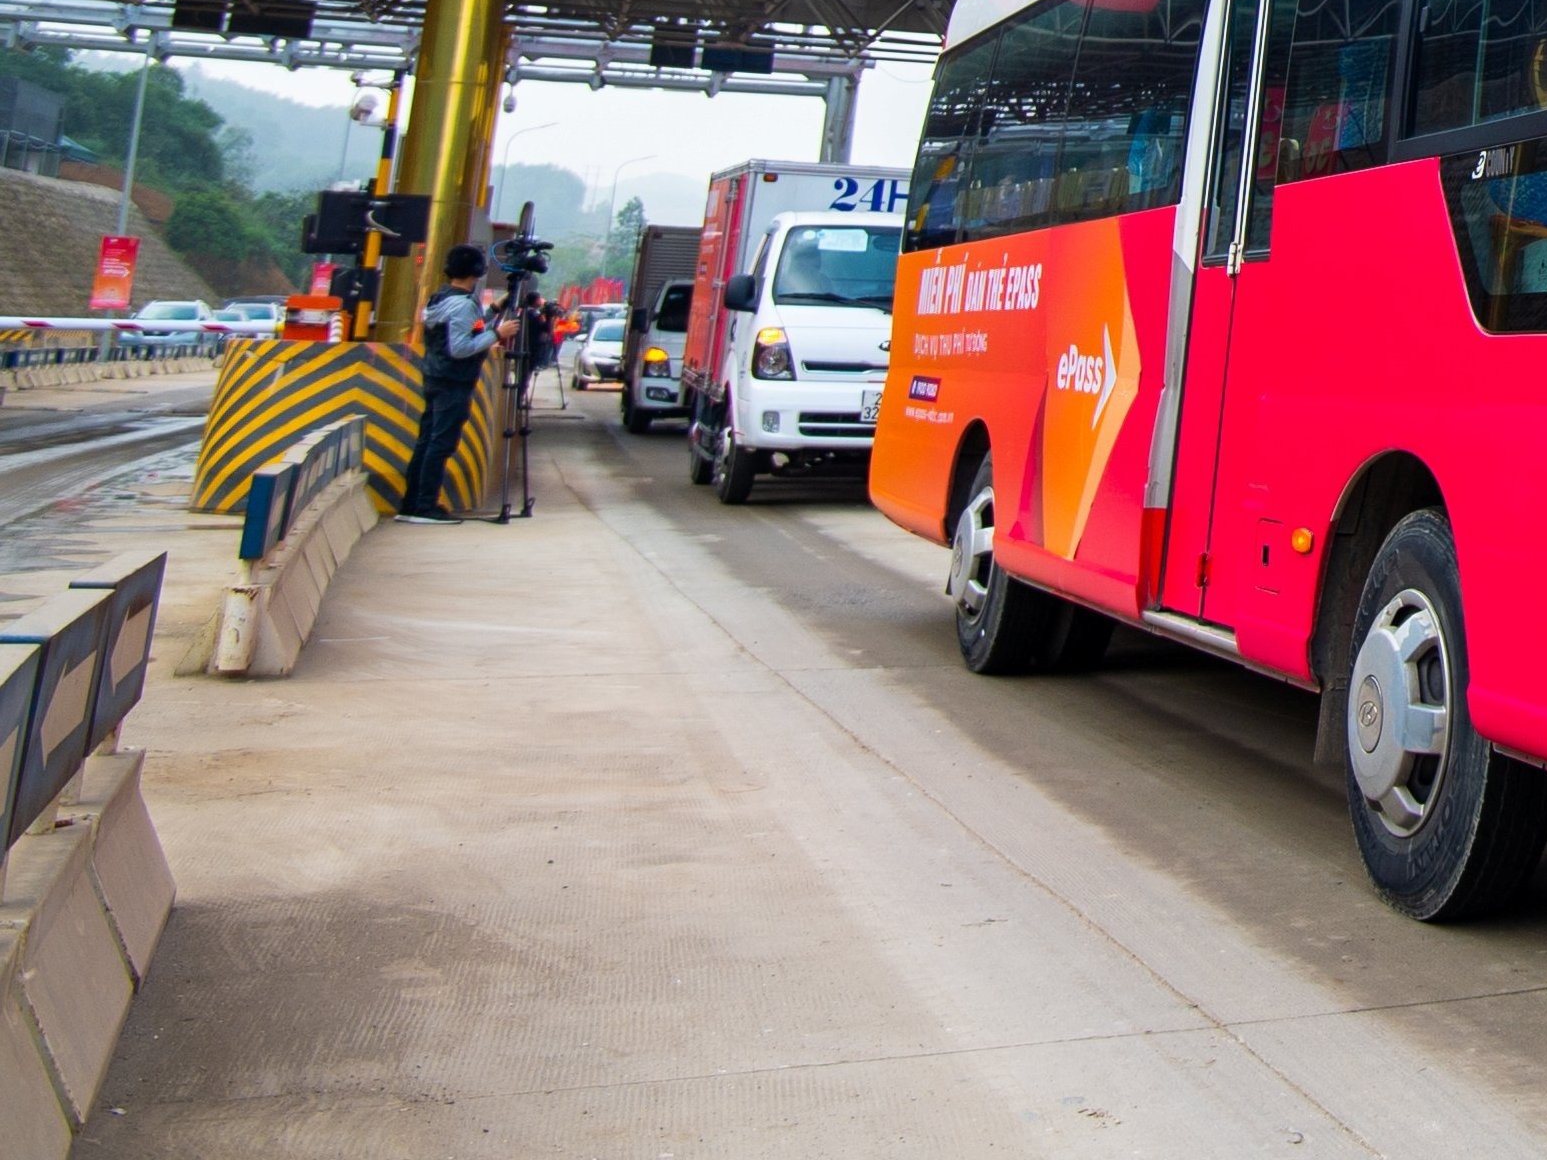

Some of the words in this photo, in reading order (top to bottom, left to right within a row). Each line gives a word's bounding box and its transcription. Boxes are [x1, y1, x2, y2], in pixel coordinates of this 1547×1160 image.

[829, 177, 910, 212] 24H
[1004, 263, 1043, 310] EPASS
[1057, 345, 1102, 394] ePass
